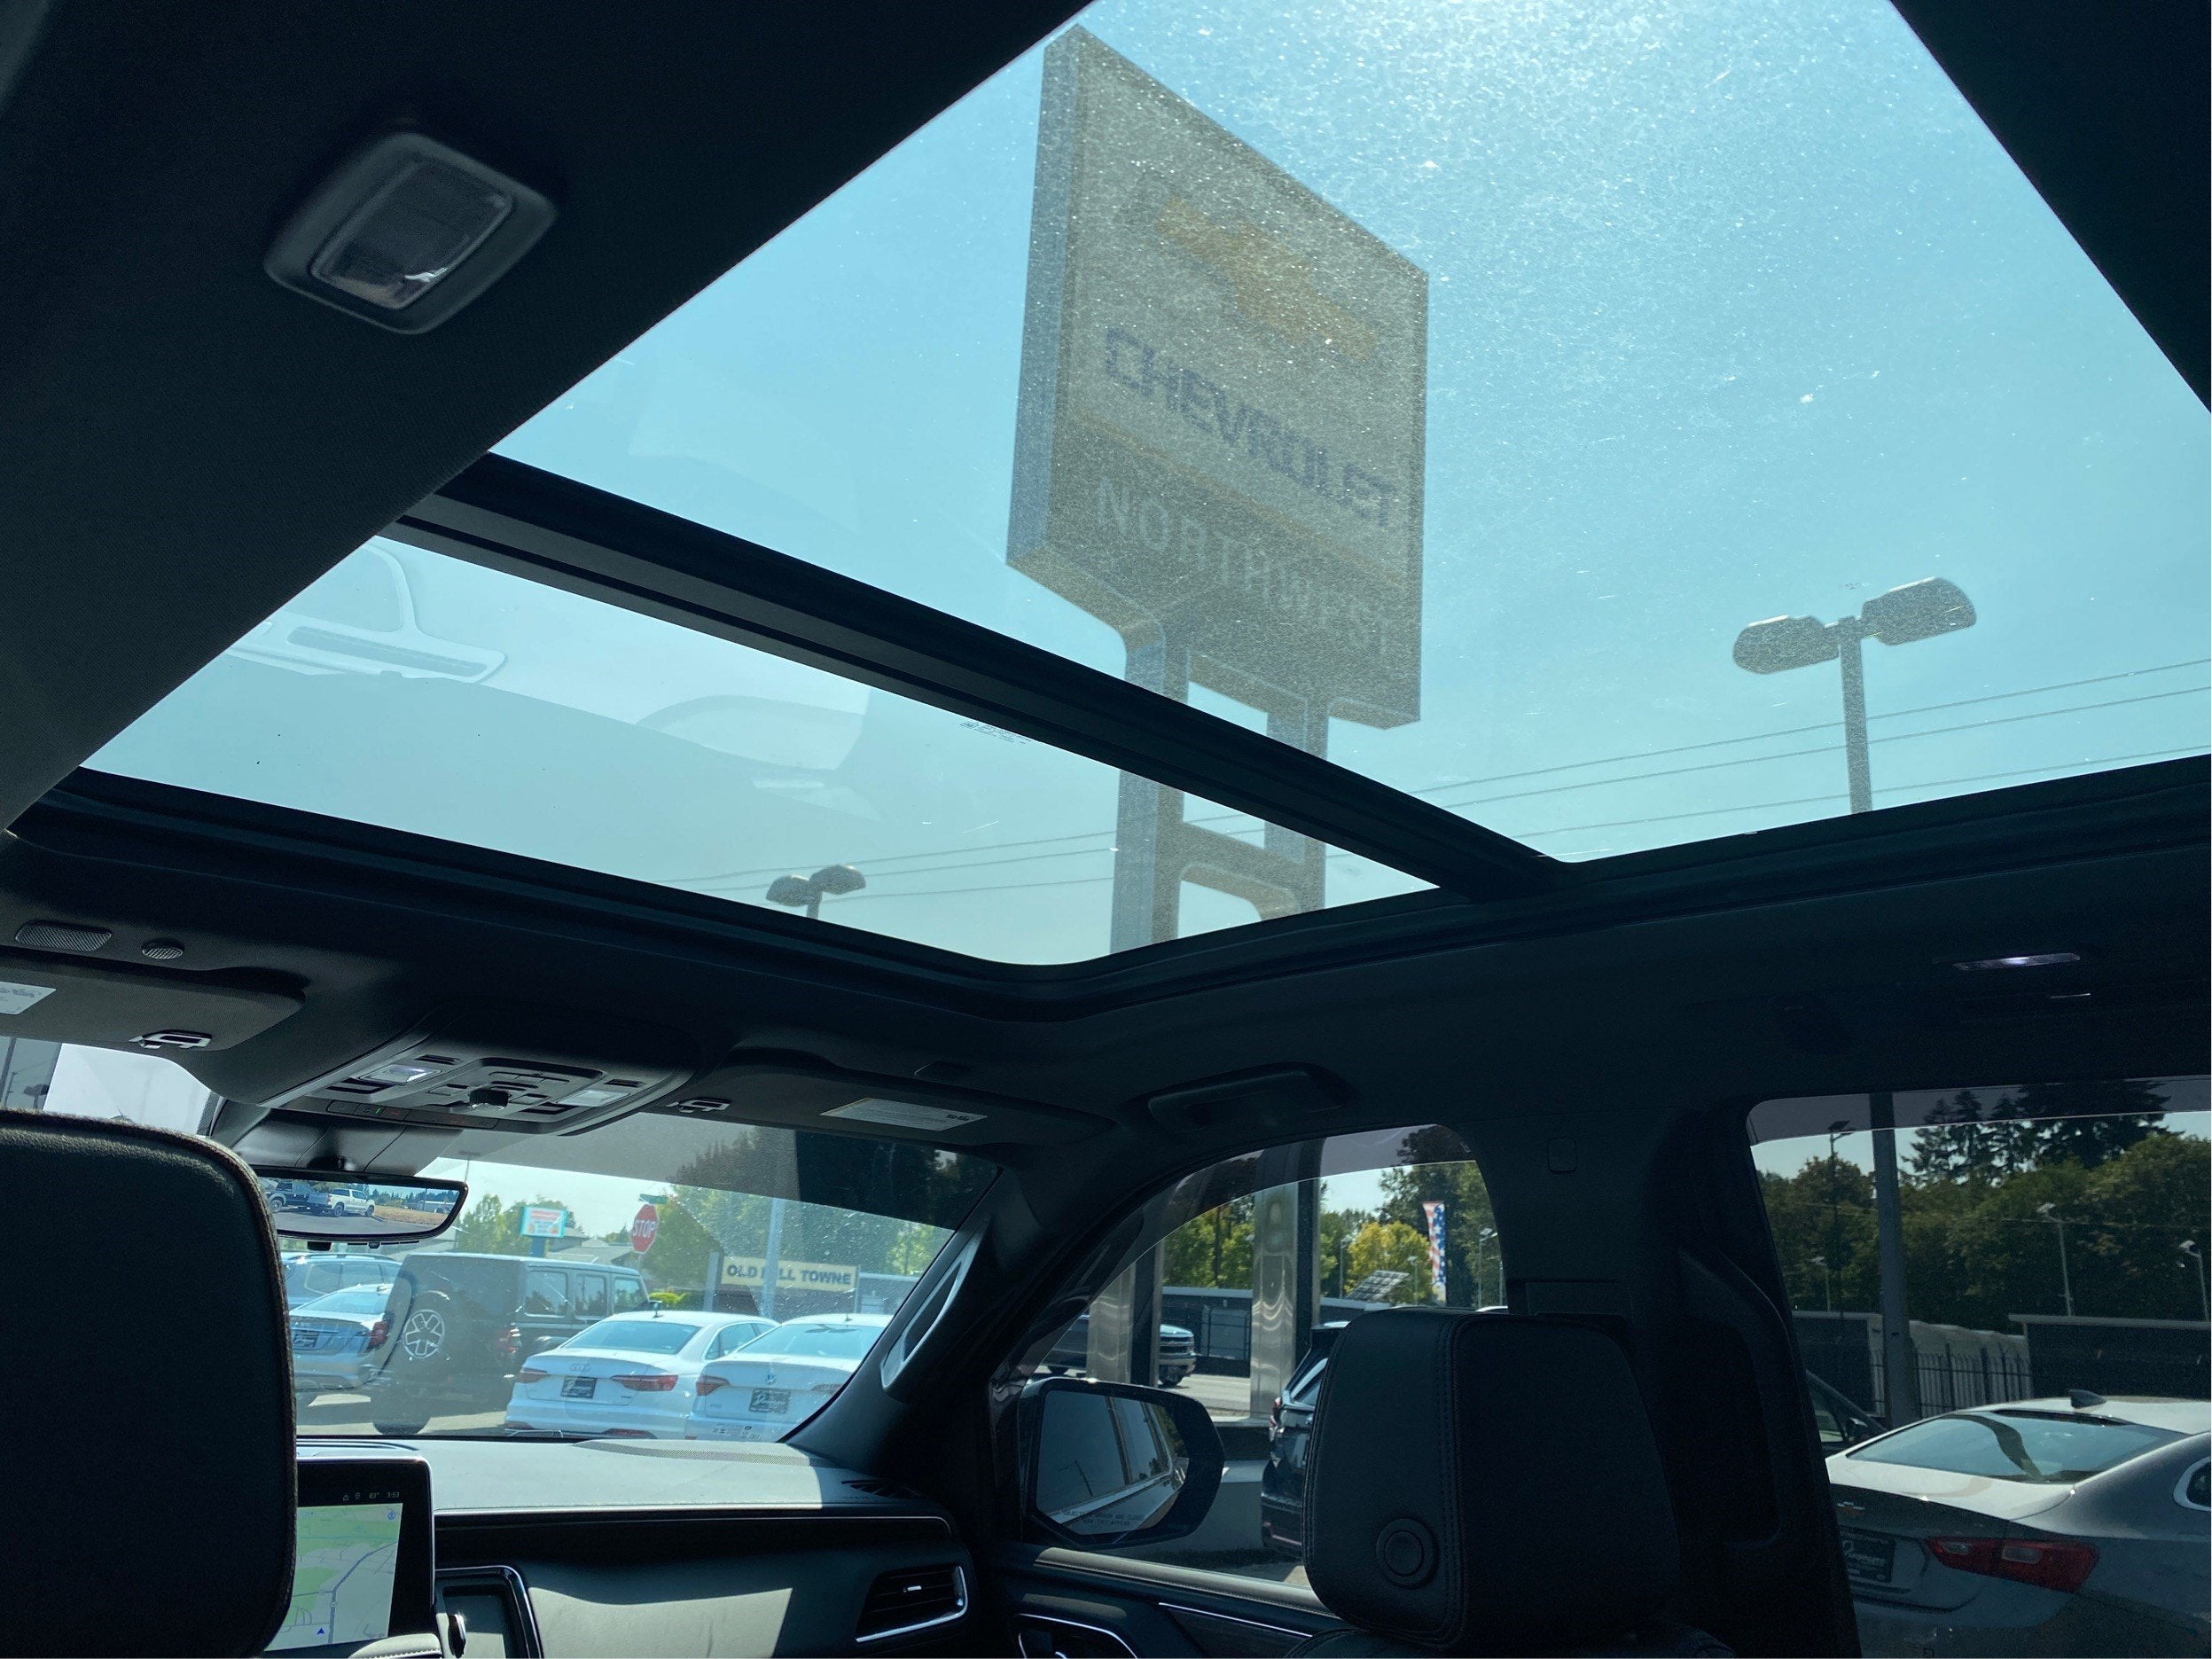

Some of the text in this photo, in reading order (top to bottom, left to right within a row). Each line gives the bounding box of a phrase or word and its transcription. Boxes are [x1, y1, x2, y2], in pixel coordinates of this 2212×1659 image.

[1105, 327, 1396, 528] CHEVROLET
[1095, 476, 1394, 654] NORTHWEST
[632, 1219, 656, 1238] STOP
[727, 1264, 852, 1285] OLD LL TOWNE
